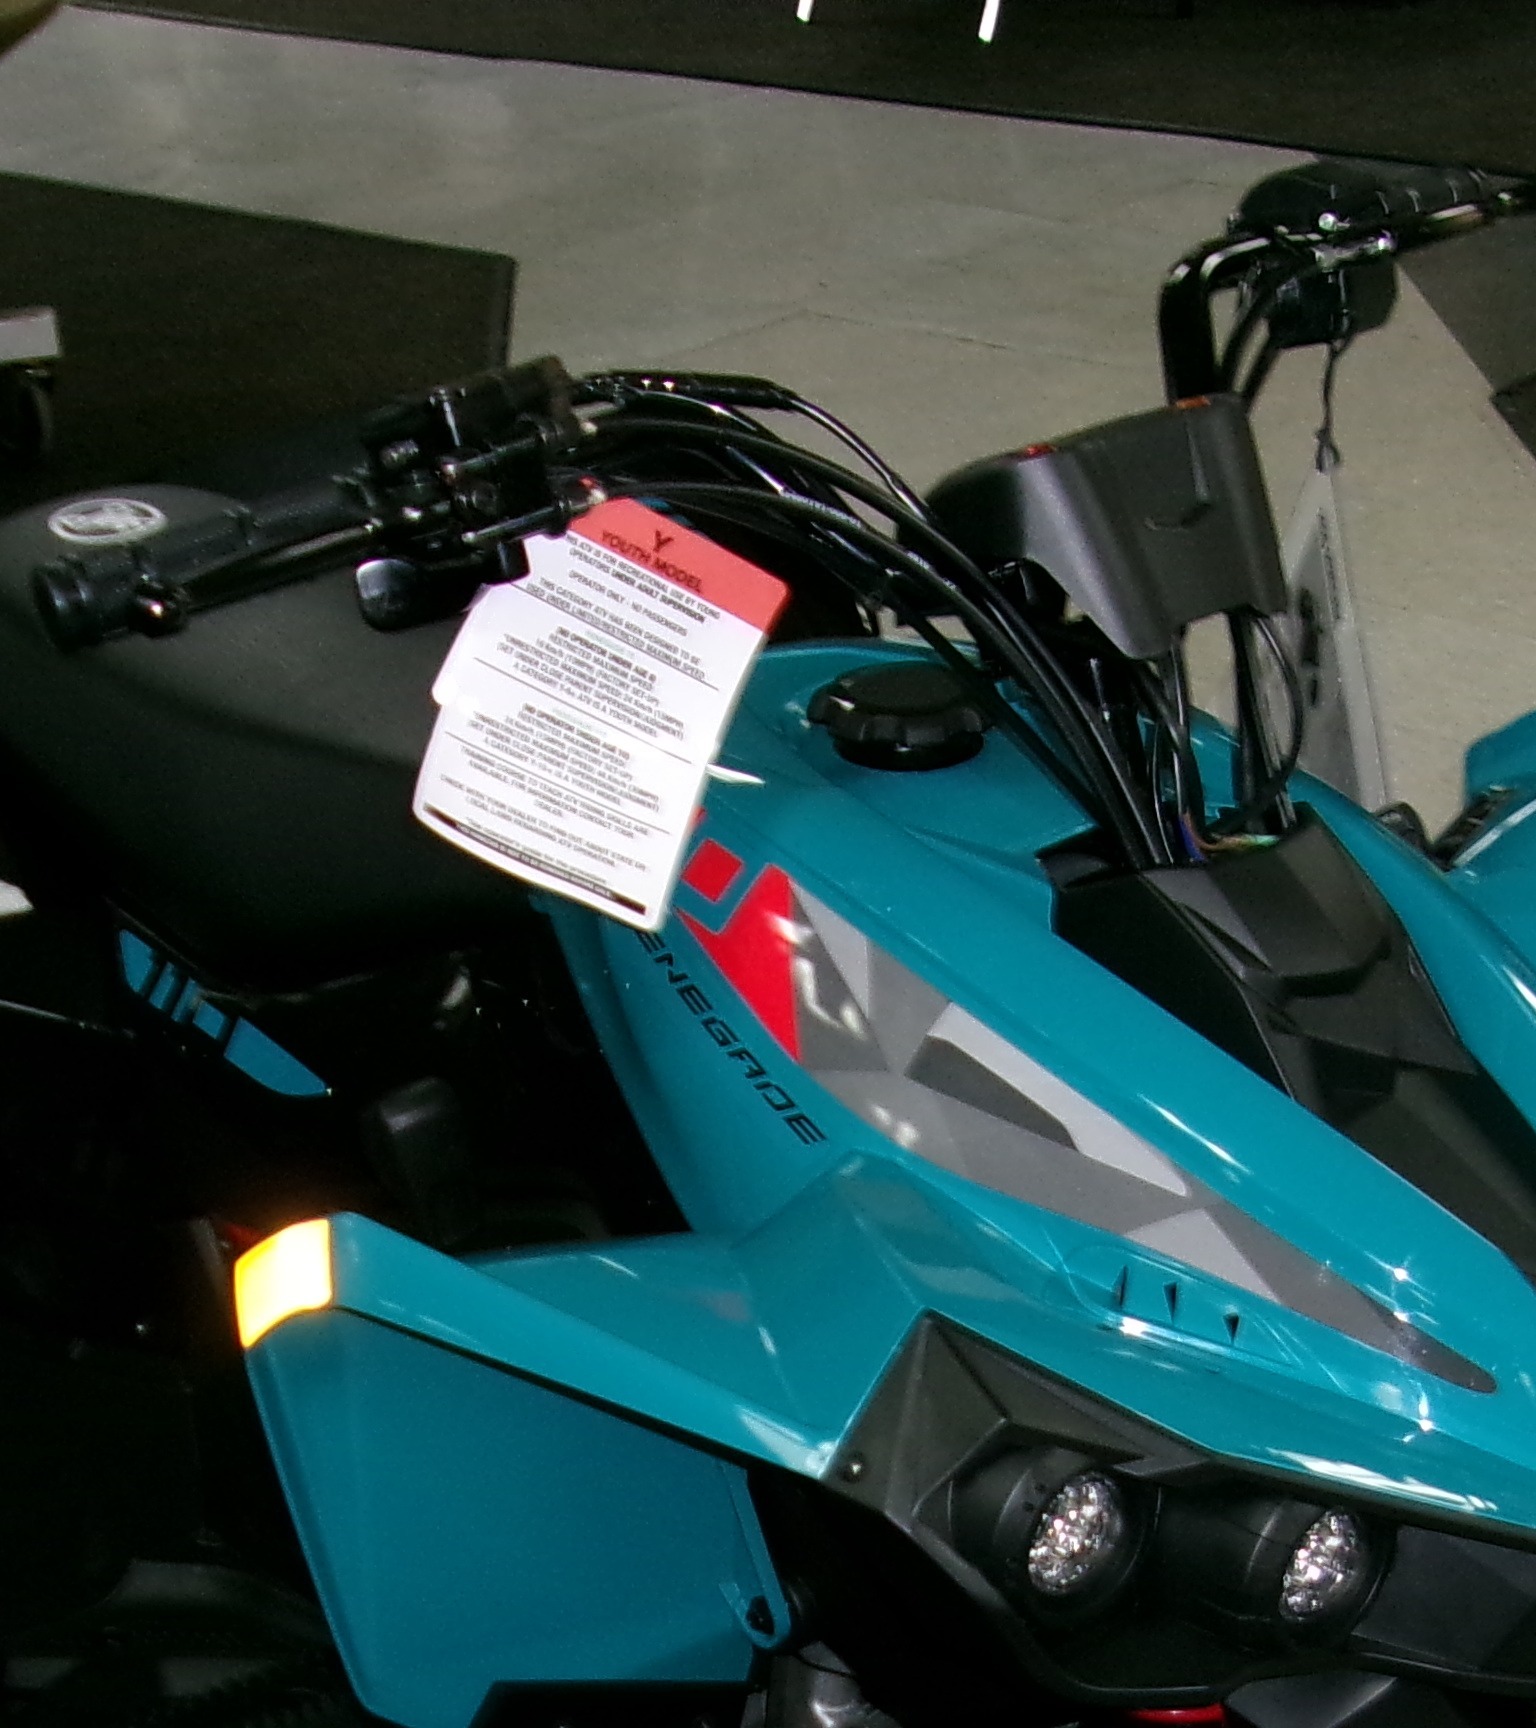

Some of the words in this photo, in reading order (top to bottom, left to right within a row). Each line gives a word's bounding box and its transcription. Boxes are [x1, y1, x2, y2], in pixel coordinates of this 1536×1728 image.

[598, 529, 652, 565] YOUTH
[651, 556, 706, 593] MODEL
[636, 931, 827, 1146] ENEGADE
